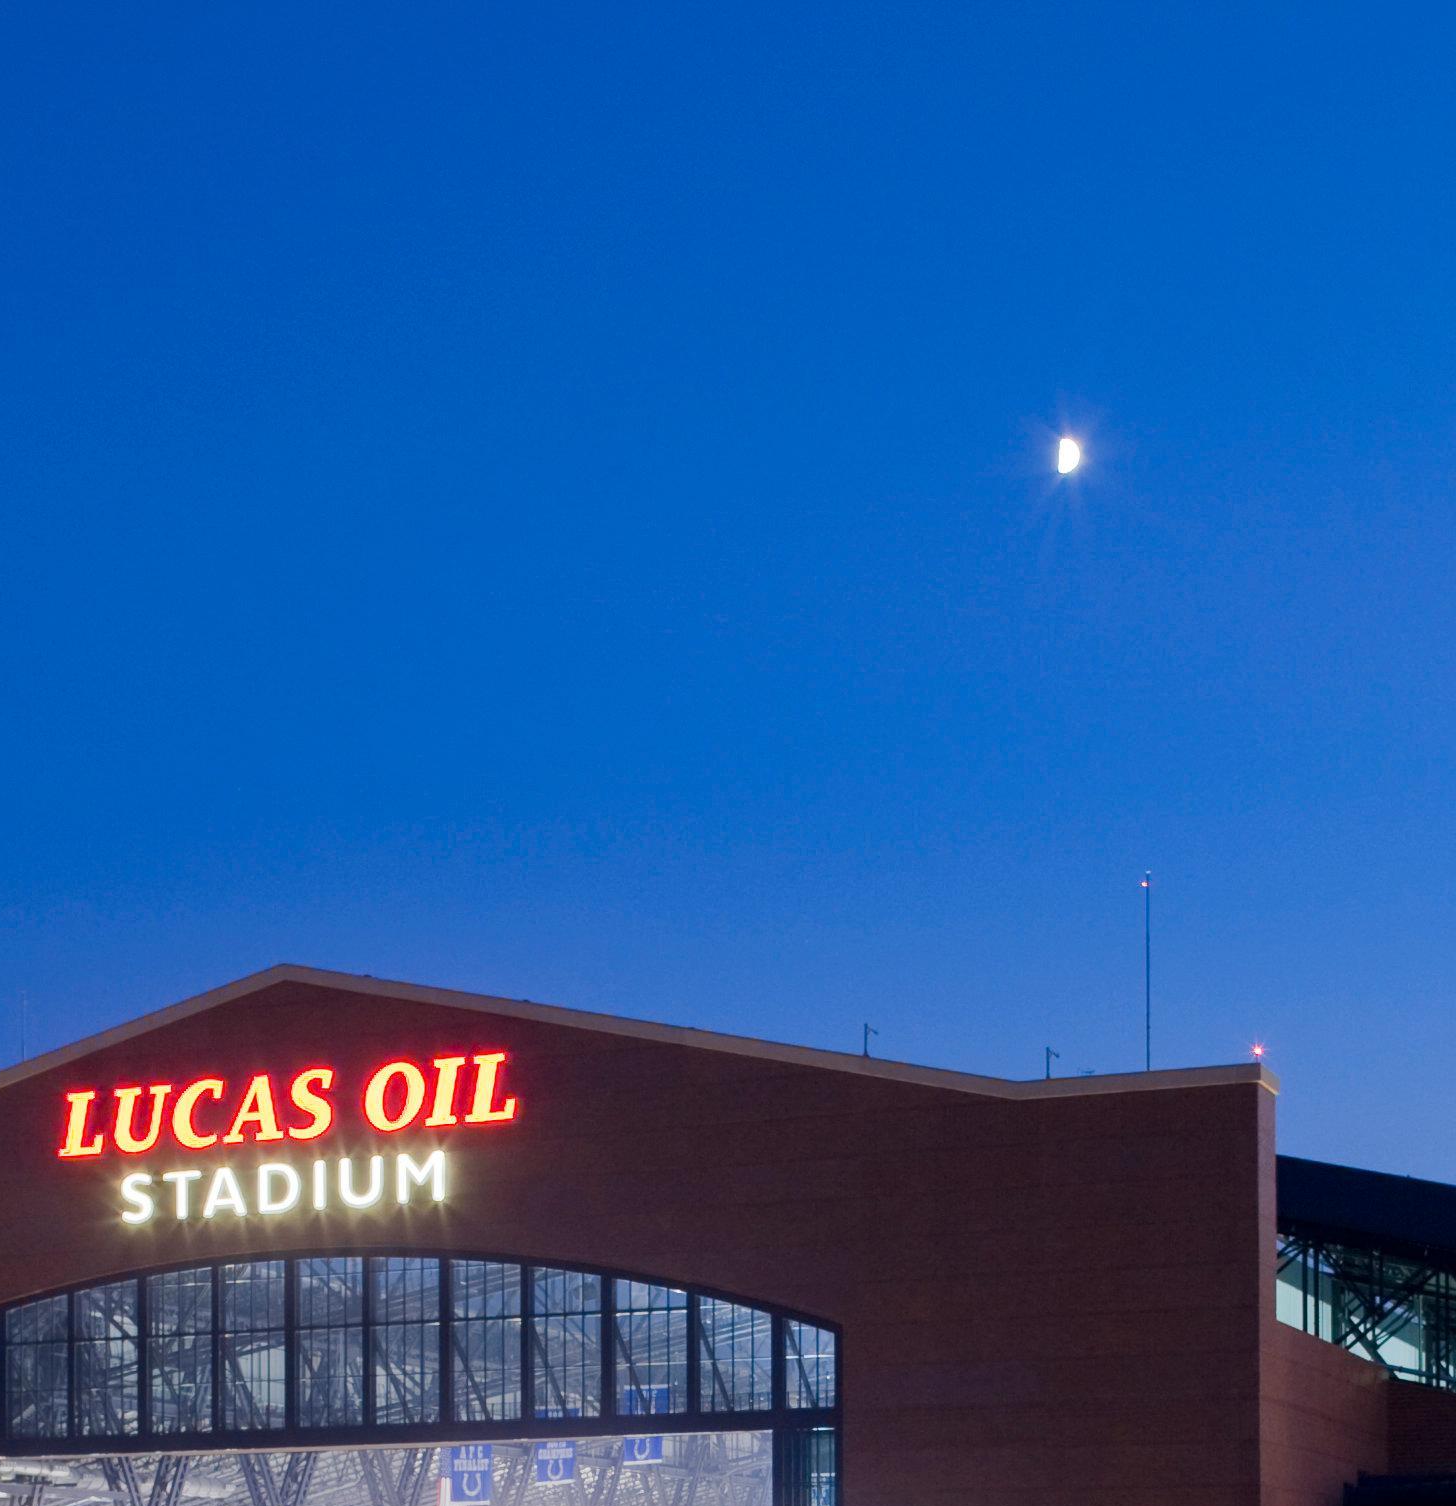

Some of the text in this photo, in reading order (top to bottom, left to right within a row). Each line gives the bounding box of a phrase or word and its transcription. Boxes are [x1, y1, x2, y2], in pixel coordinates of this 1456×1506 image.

[57, 1051, 517, 1158] LUCAS OIL
[119, 1149, 447, 1225] STADIUM
